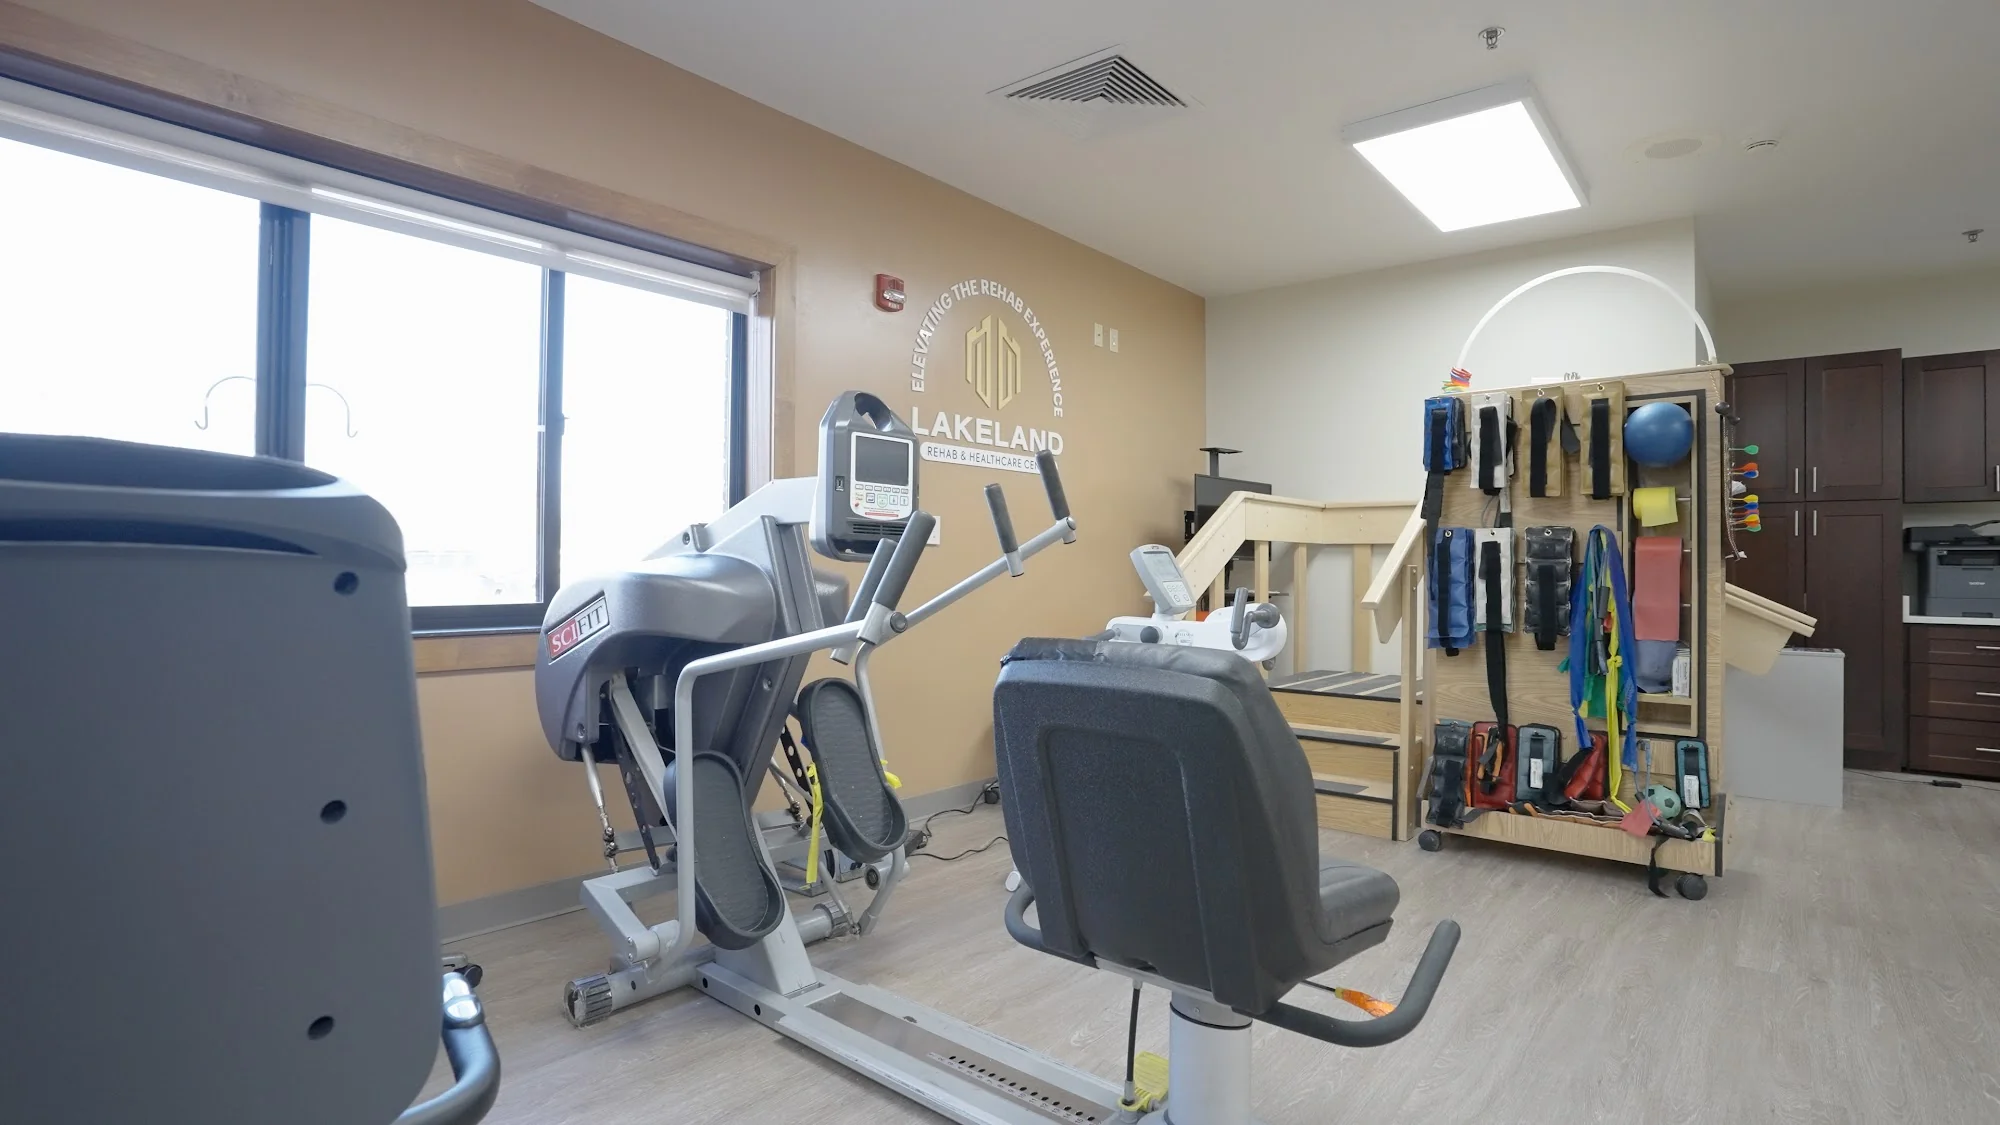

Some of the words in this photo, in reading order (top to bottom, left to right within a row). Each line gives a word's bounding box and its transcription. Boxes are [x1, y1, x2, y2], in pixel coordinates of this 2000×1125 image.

[911, 292, 953, 393] ELEVATING
[950, 279, 979, 301] THE
[980, 278, 1024, 313] REHAB
[1023, 307, 1063, 418] EXPERIENCE
[911, 406, 1064, 456] LAKELAND
[927, 446, 958, 460] REHAB
[960, 451, 967, 461] &
[969, 452, 1022, 468] HEALTHCARE
[552, 606, 602, 652] SCIFIT
